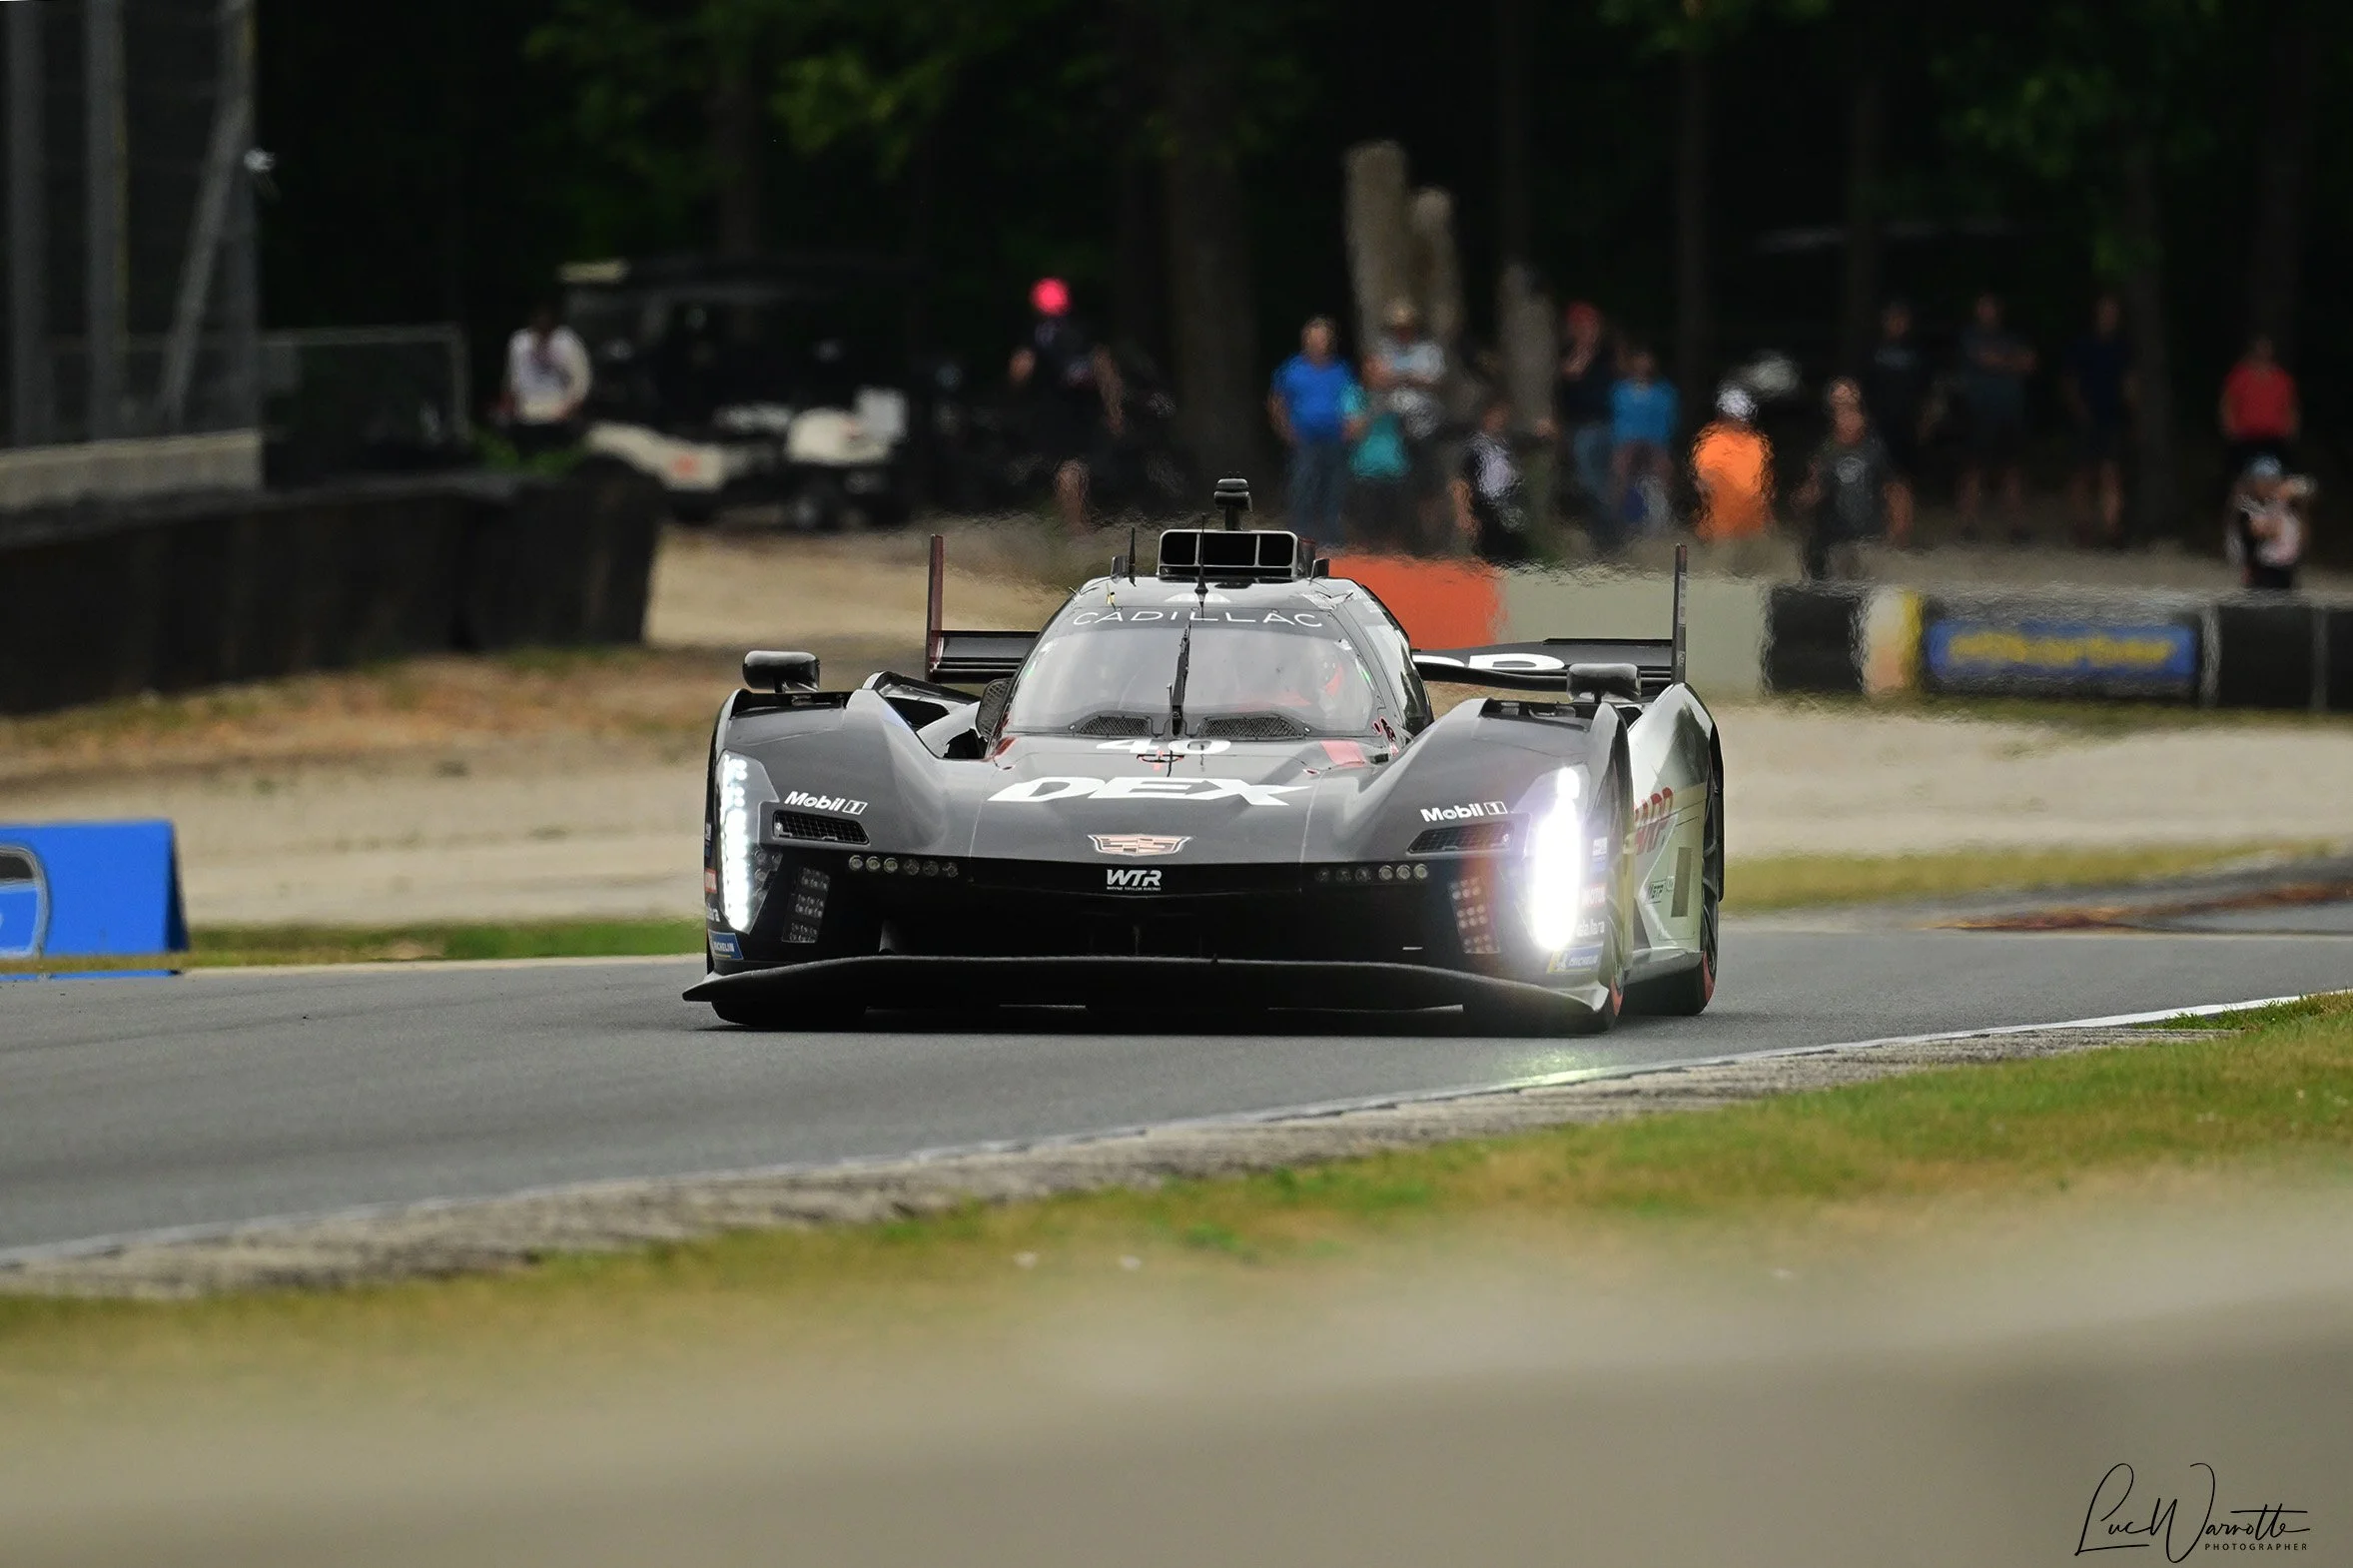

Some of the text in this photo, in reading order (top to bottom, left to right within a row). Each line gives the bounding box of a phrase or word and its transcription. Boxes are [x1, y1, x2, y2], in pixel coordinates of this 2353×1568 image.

[1073, 611, 1322, 628] CADILLAC
[988, 777, 1313, 806] DEX
[784, 791, 846, 812] Mobil
[1420, 803, 1484, 822] Mobil
[1107, 869, 1162, 887] WTR
